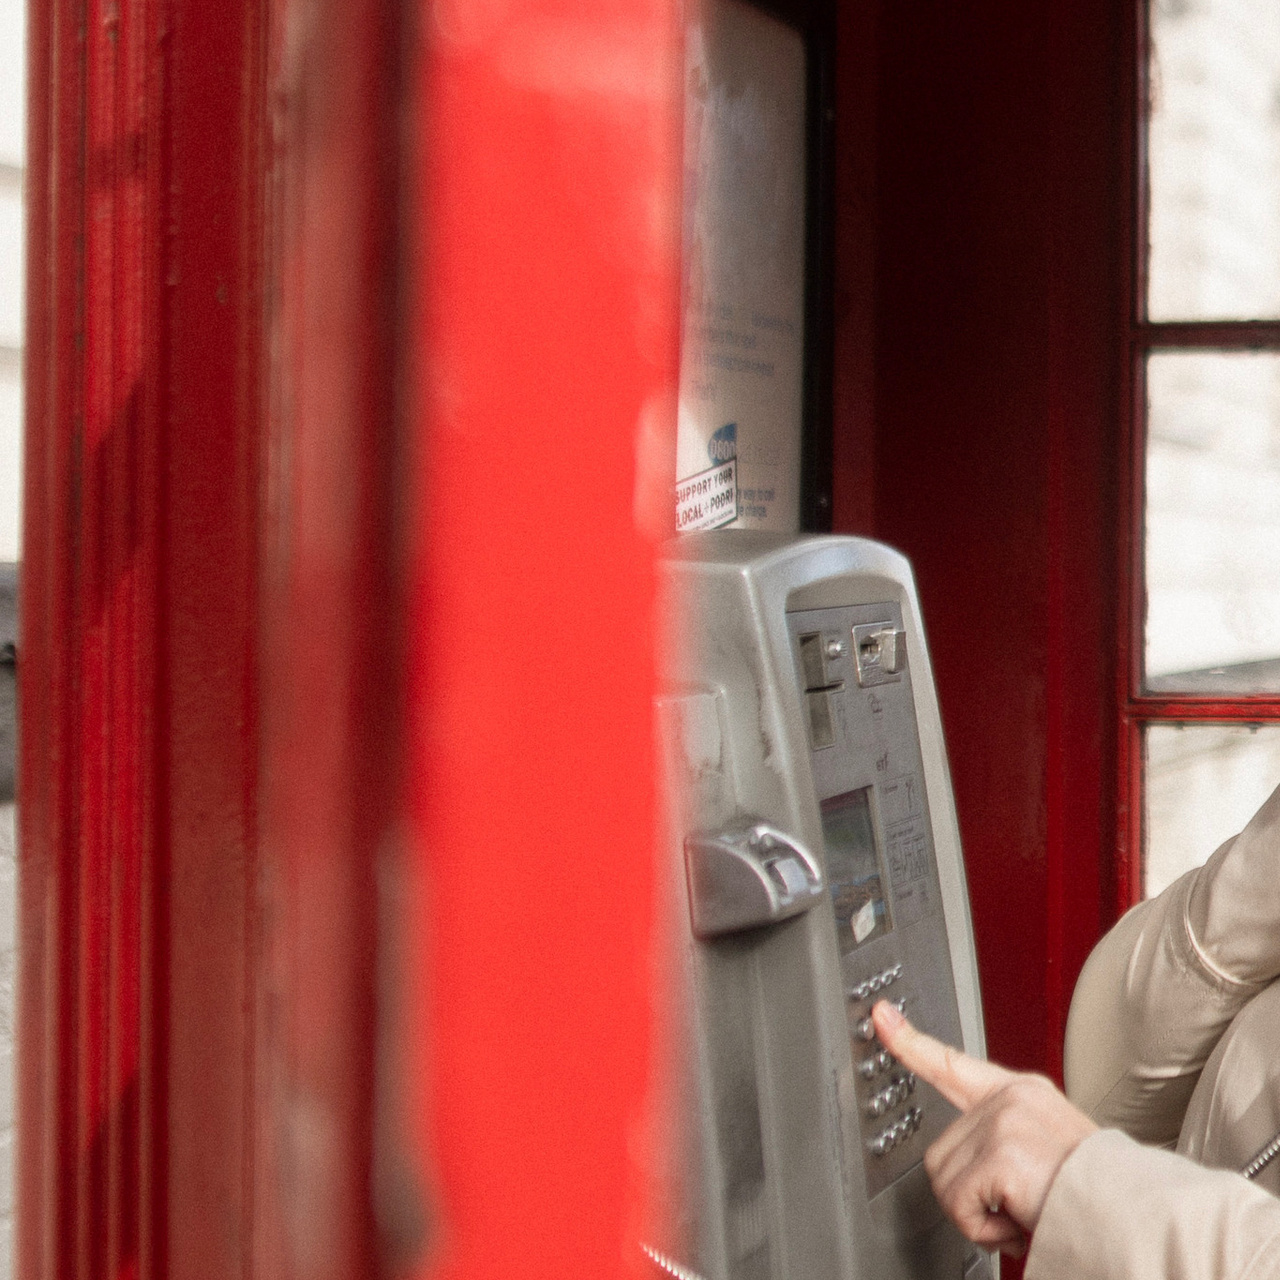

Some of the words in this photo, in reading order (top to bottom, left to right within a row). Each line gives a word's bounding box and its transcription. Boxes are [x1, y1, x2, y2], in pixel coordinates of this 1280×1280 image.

[676, 477, 712, 505] SUPPORT
[714, 467, 733, 488] YOUR
[676, 503, 704, 528] LOCAL
